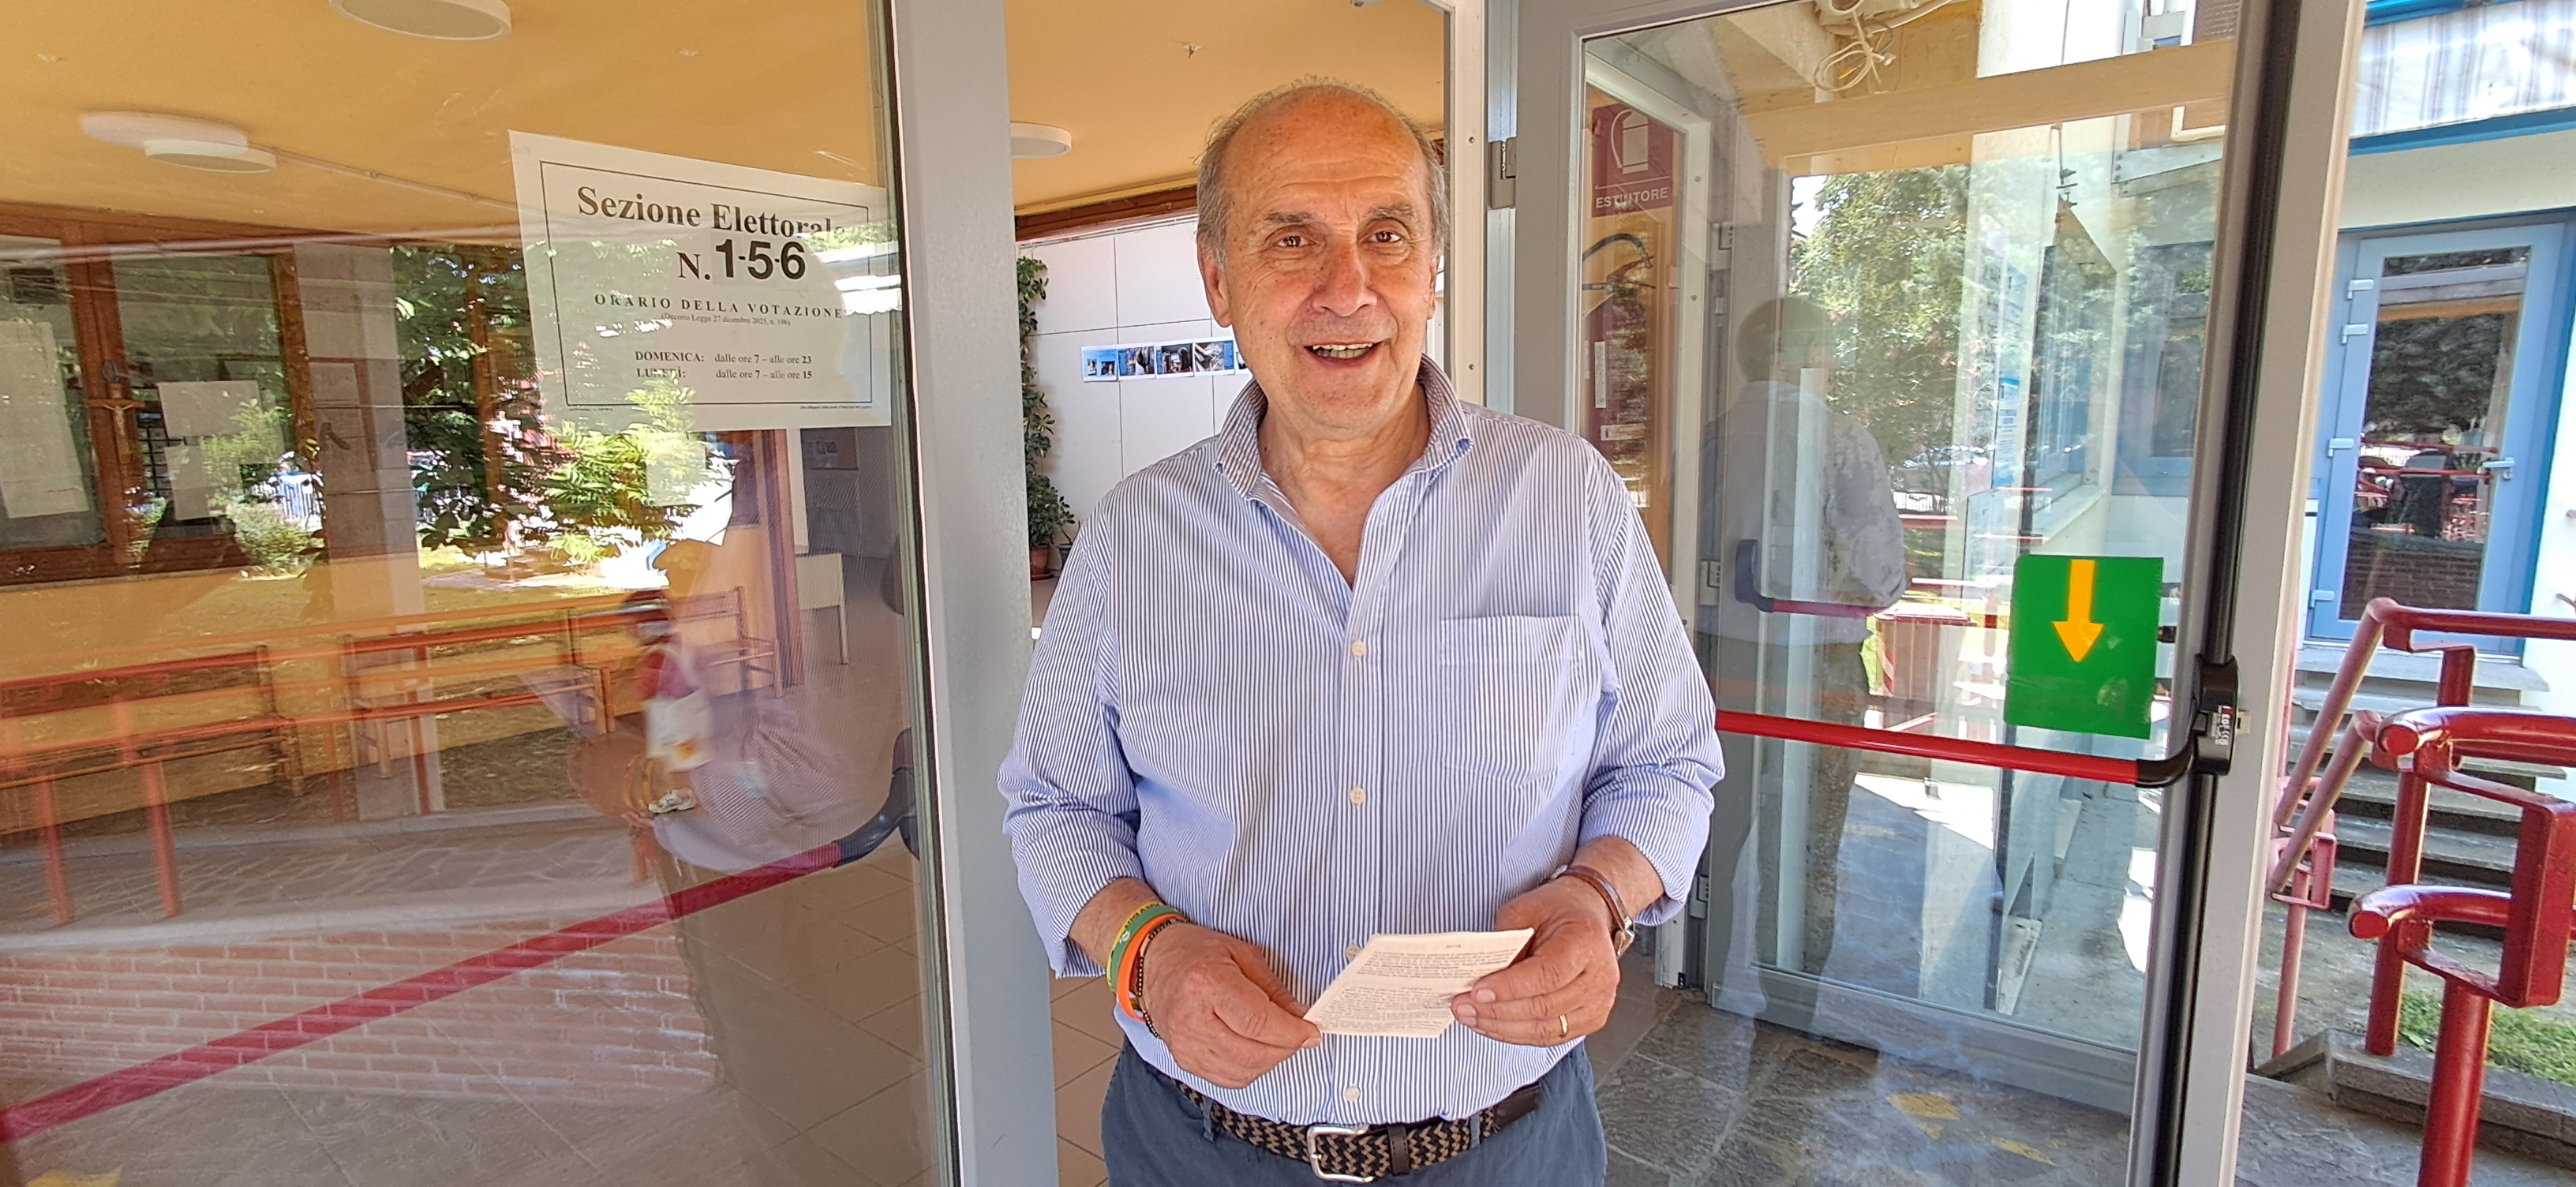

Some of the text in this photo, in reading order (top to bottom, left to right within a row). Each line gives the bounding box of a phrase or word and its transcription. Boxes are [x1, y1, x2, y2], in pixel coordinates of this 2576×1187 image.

[577, 186, 702, 227] Sezione
[677, 252, 710, 280] N.
[594, 294, 842, 318] ORARIO DELLA VOTAZIONE
[635, 351, 705, 362] DOMENICA:
[714, 353, 736, 363] dalle
[754, 354, 760, 363] 7
[769, 354, 784, 363] alle
[802, 355, 812, 364] 23
[716, 369, 737, 378] dalle
[754, 369, 761, 379] 7
[770, 370, 785, 379] alle
[803, 370, 813, 379] 15
